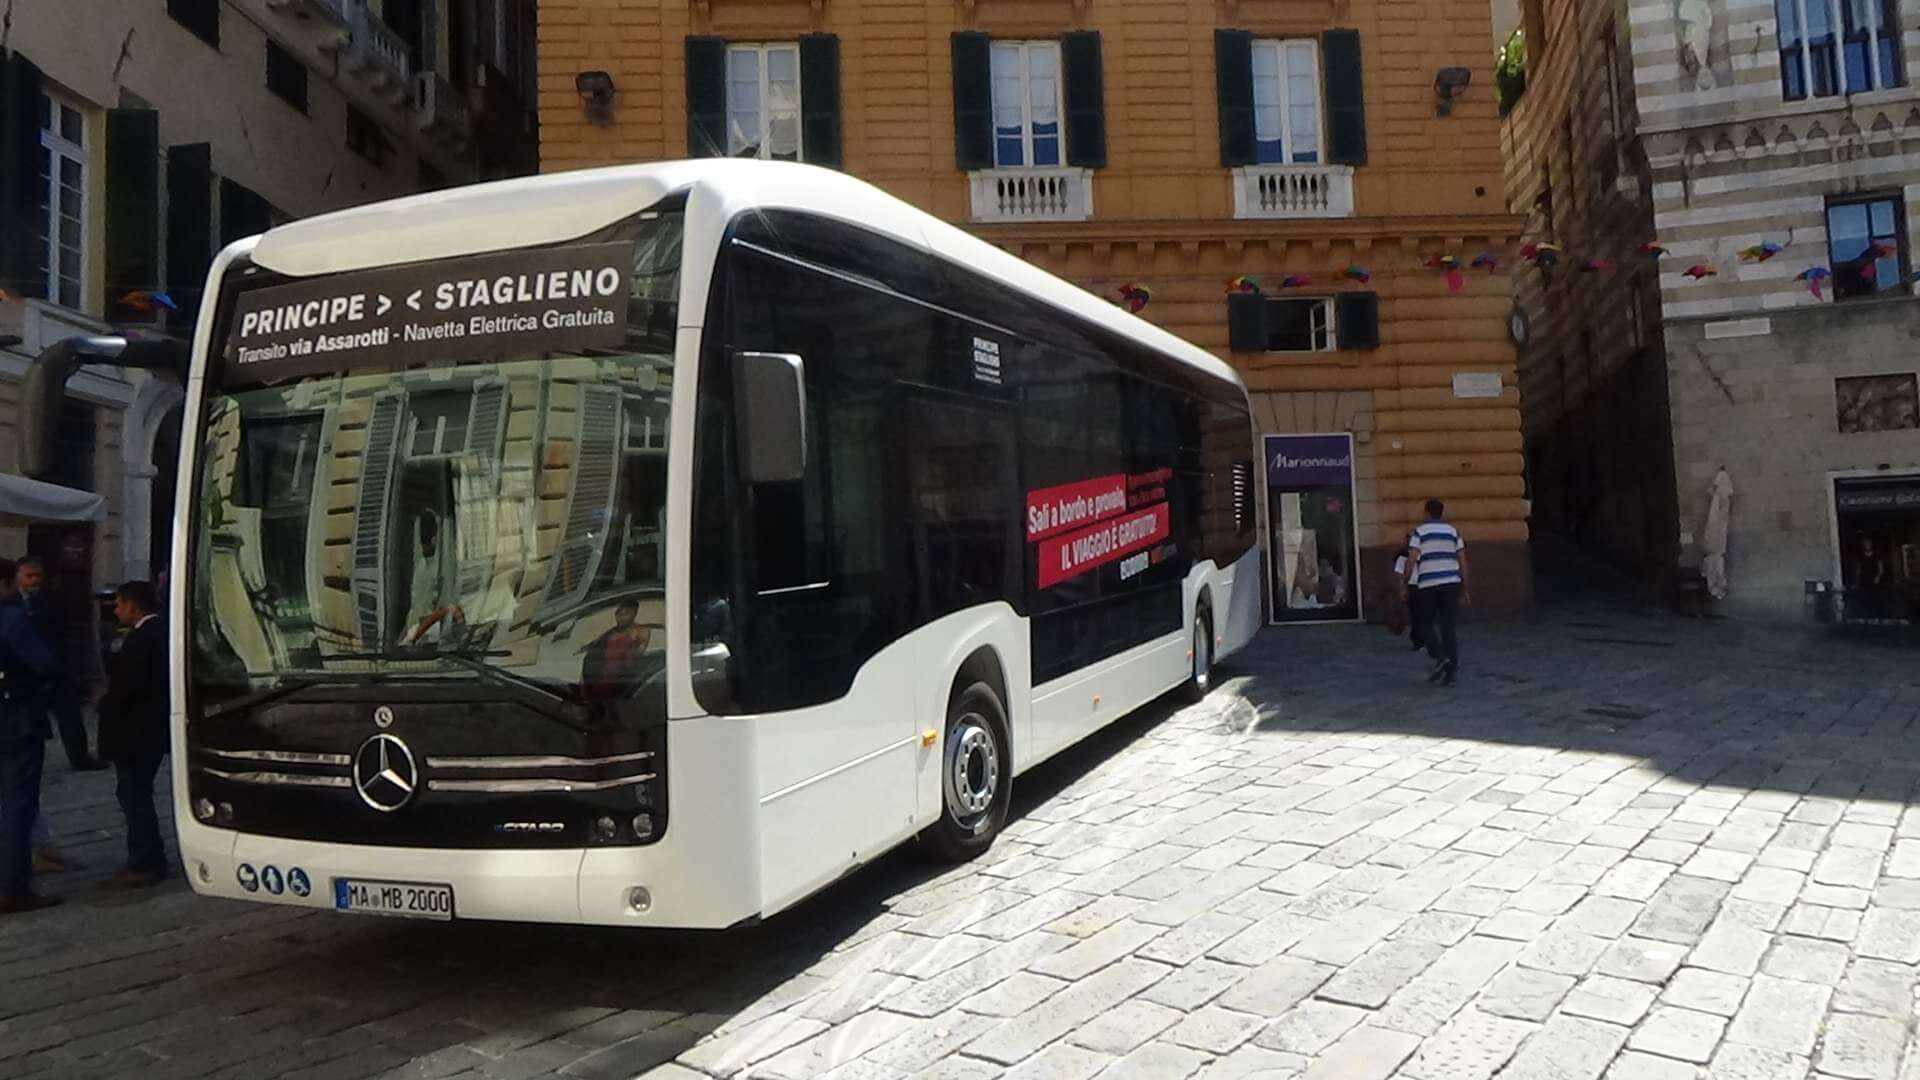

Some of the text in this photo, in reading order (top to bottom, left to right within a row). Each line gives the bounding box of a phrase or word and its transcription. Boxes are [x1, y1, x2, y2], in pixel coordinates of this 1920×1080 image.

[241, 294, 365, 337] PRINCIPE
[435, 267, 619, 310] STAGLIENO
[237, 344, 287, 364] Transito
[290, 338, 313, 356] via
[315, 327, 389, 353] Assarotti
[404, 320, 465, 342] Navetta
[470, 315, 538, 336] Elettrica
[543, 307, 614, 328] Gratuita
[1271, 453, 1350, 471] Marionnaud
[1028, 503, 1049, 533] Sali
[1051, 507, 1058, 527] a
[1060, 496, 1086, 524] bordo
[1088, 498, 1094, 514] e
[1061, 543, 1071, 571] IL
[1073, 529, 1111, 565] VIAGGIO
[495, 822, 565, 832] CITARO
[348, 886, 449, 912] MA MB 2000
